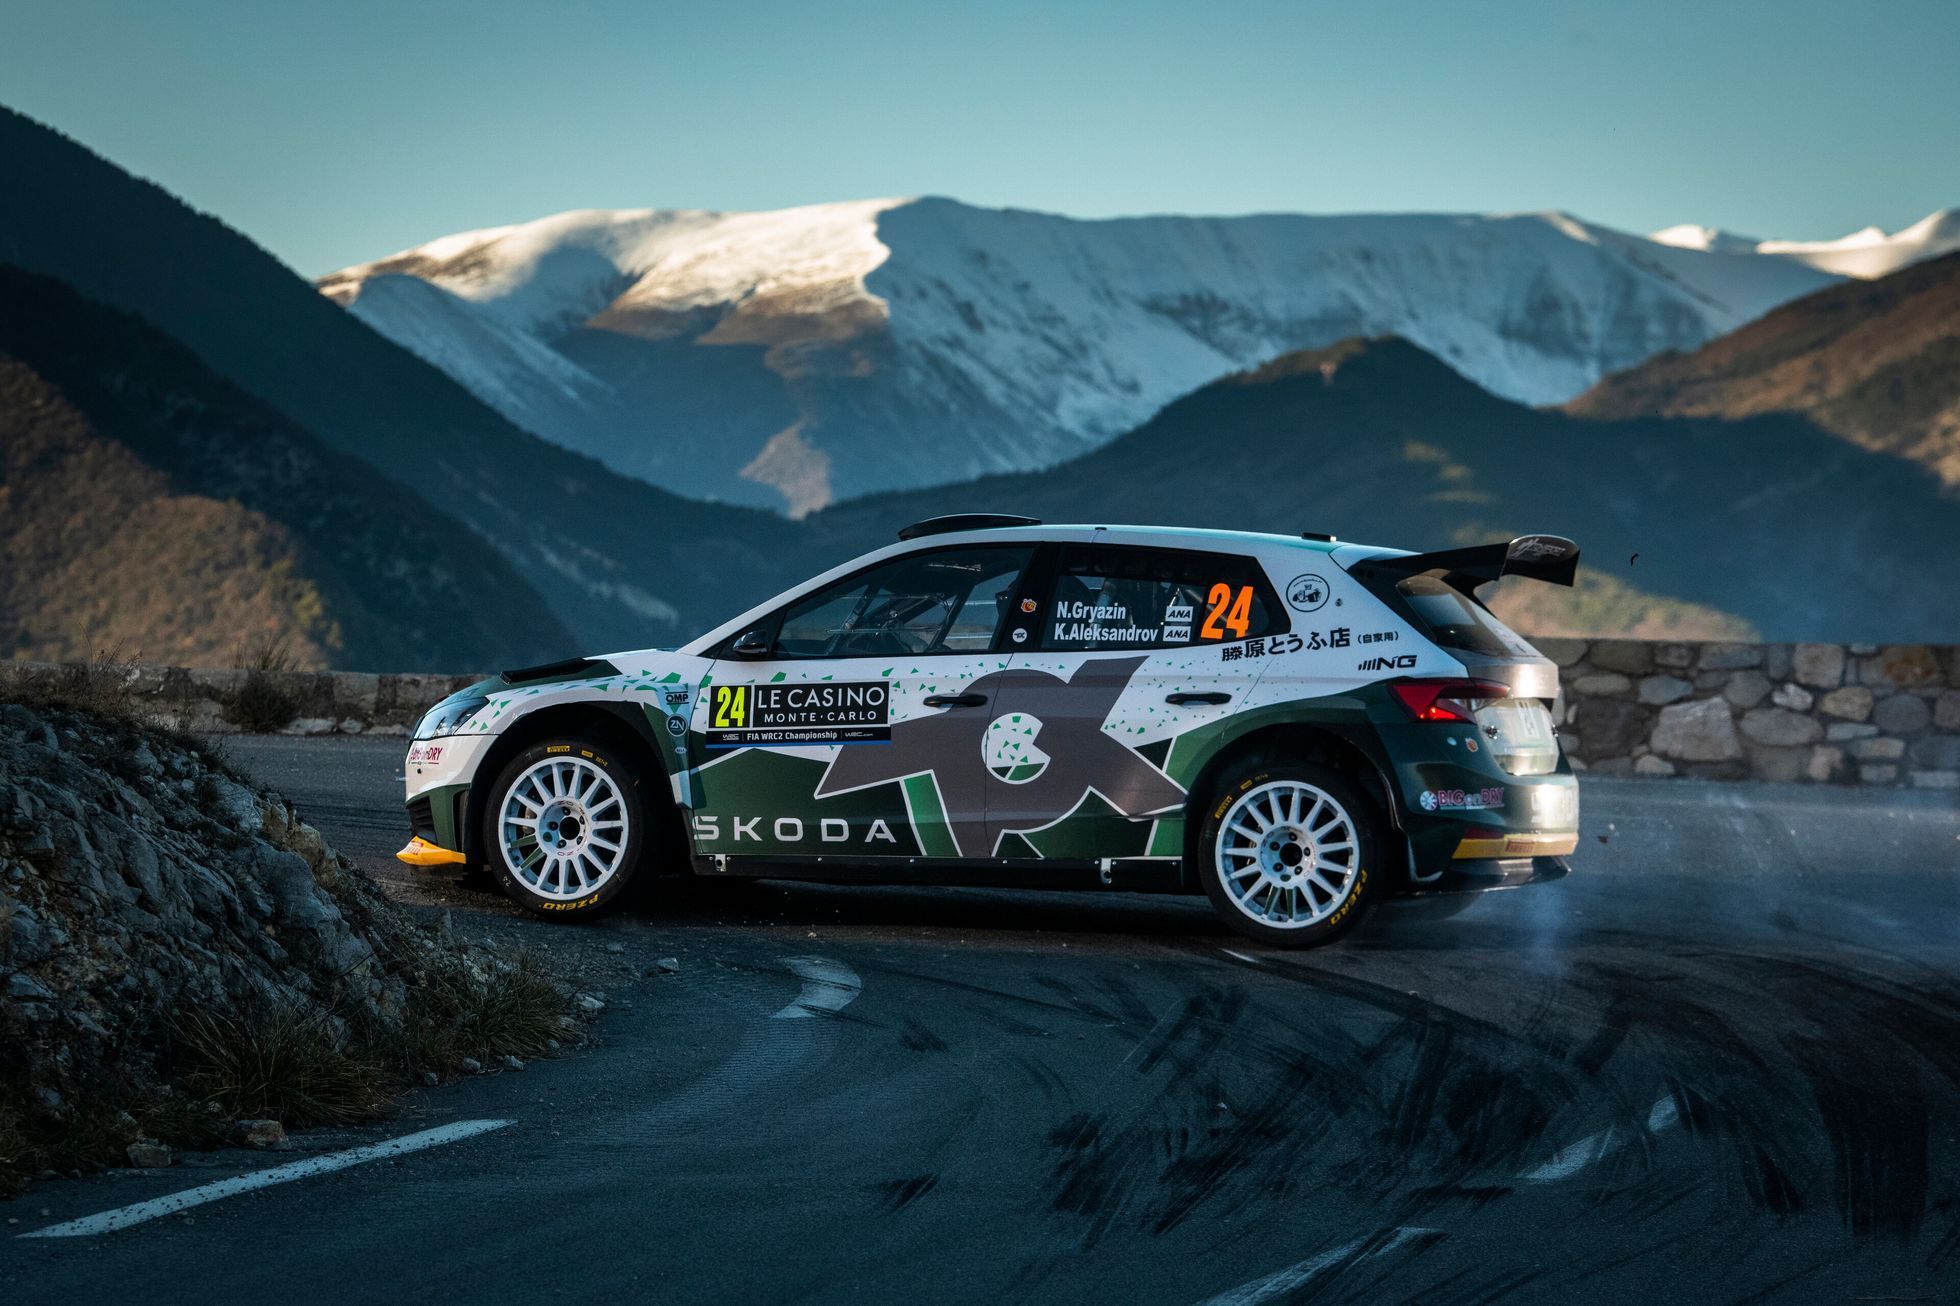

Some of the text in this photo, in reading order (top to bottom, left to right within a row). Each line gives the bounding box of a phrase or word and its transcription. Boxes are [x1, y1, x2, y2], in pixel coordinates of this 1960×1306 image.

[1056, 601, 1127, 623] N.Gryazin
[1167, 609, 1190, 619] ANA
[1201, 583, 1254, 640] 24
[1054, 623, 1158, 642] K.Aleksandrov
[1165, 630, 1188, 639] ANA
[666, 693, 689, 703] OMP
[715, 686, 745, 727] 24
[757, 686, 885, 709] LE CASINO
[747, 732, 760, 741] FIA
[761, 731, 783, 741] WRC2
[785, 730, 838, 741] Championship
